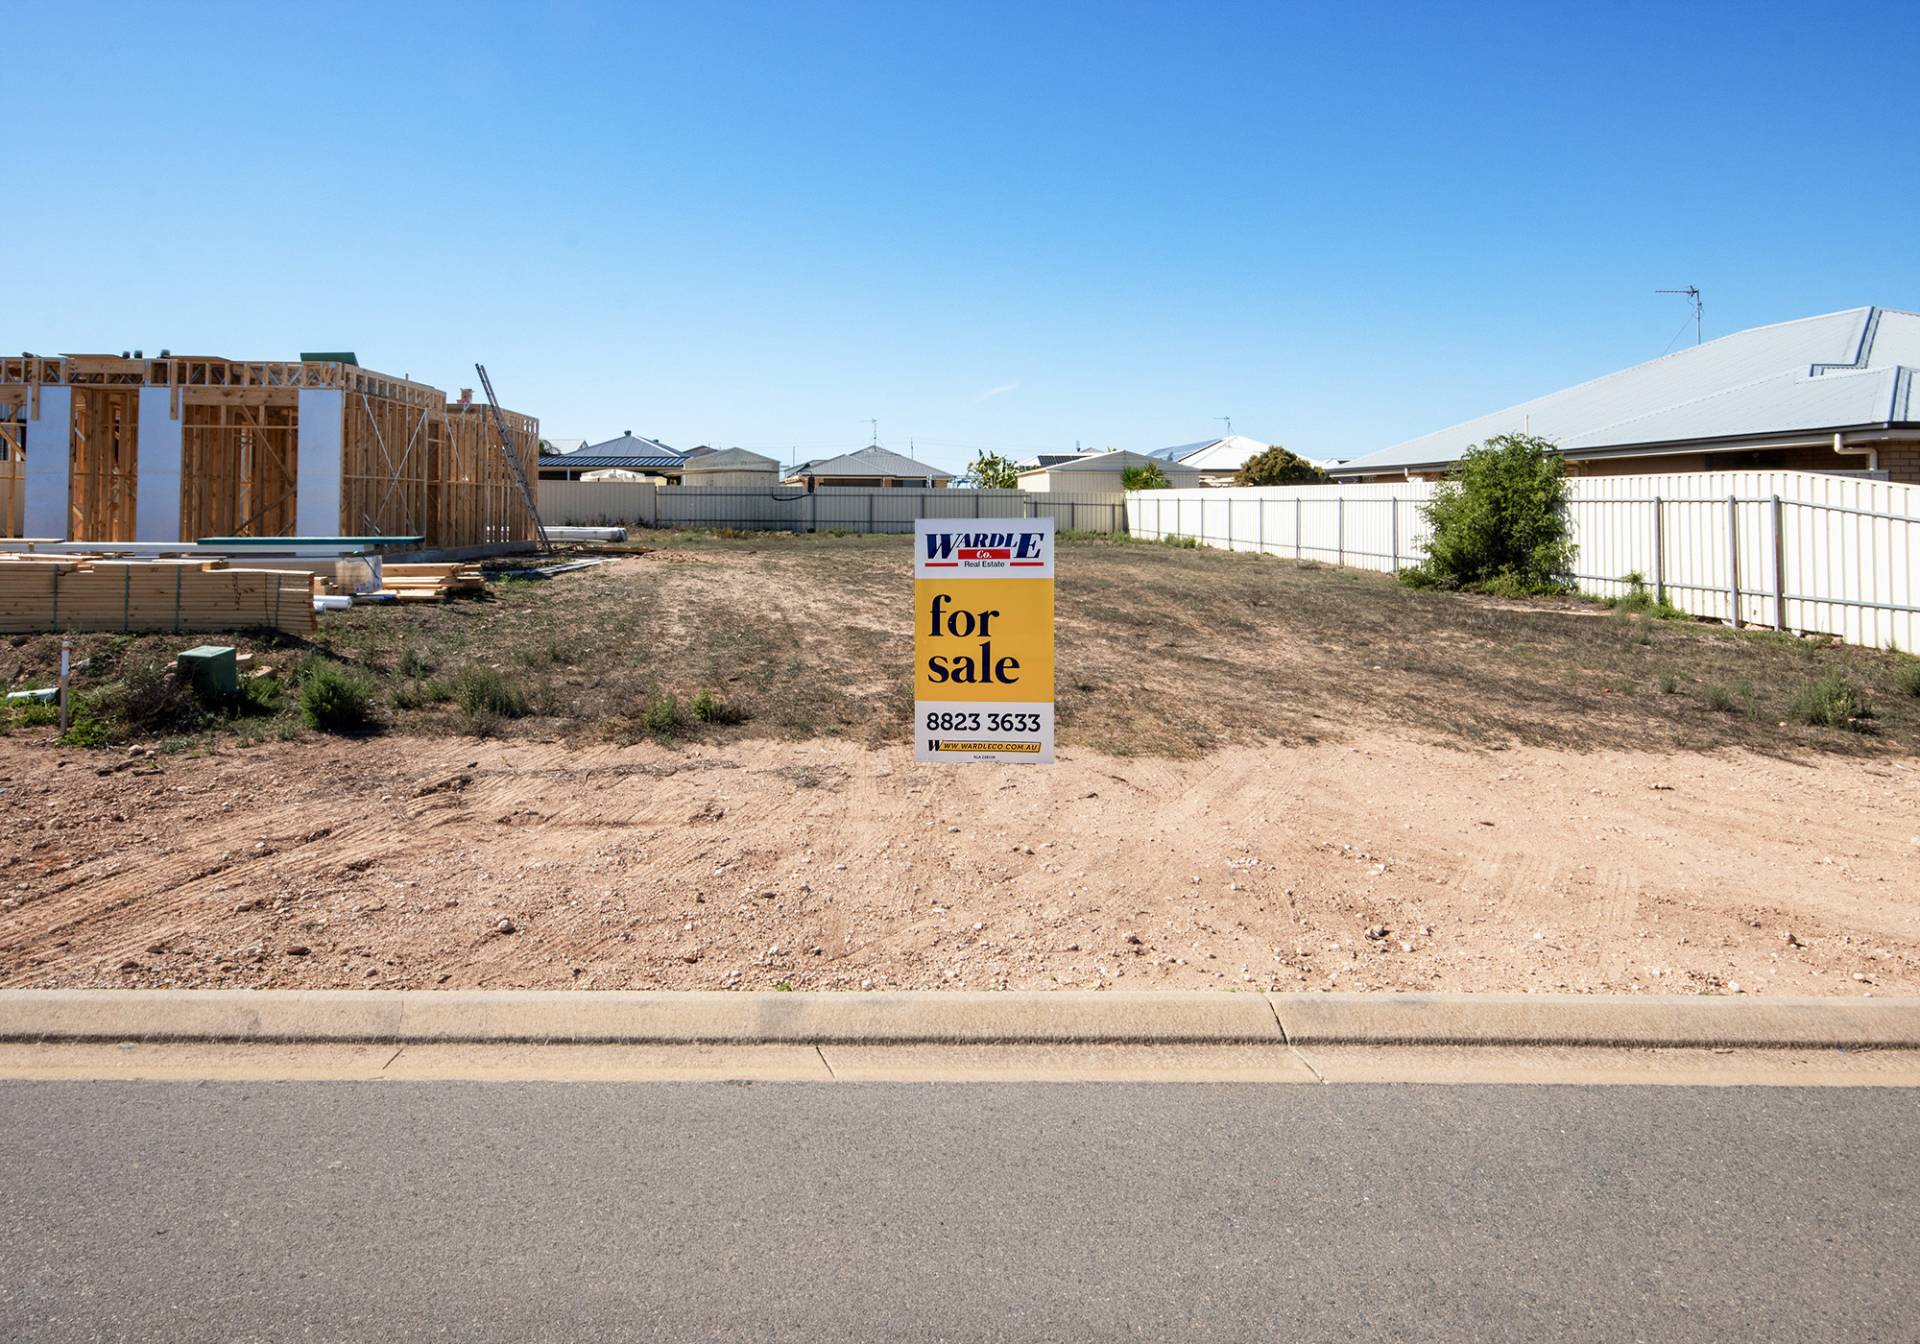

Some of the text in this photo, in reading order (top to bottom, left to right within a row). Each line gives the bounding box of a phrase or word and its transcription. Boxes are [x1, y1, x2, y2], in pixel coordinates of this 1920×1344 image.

[925, 533, 1044, 559] WARDLE
[976, 550, 992, 559] Co.
[928, 594, 1000, 637] for
[928, 641, 1021, 684] sale
[926, 712, 1041, 732] 8823 3633
